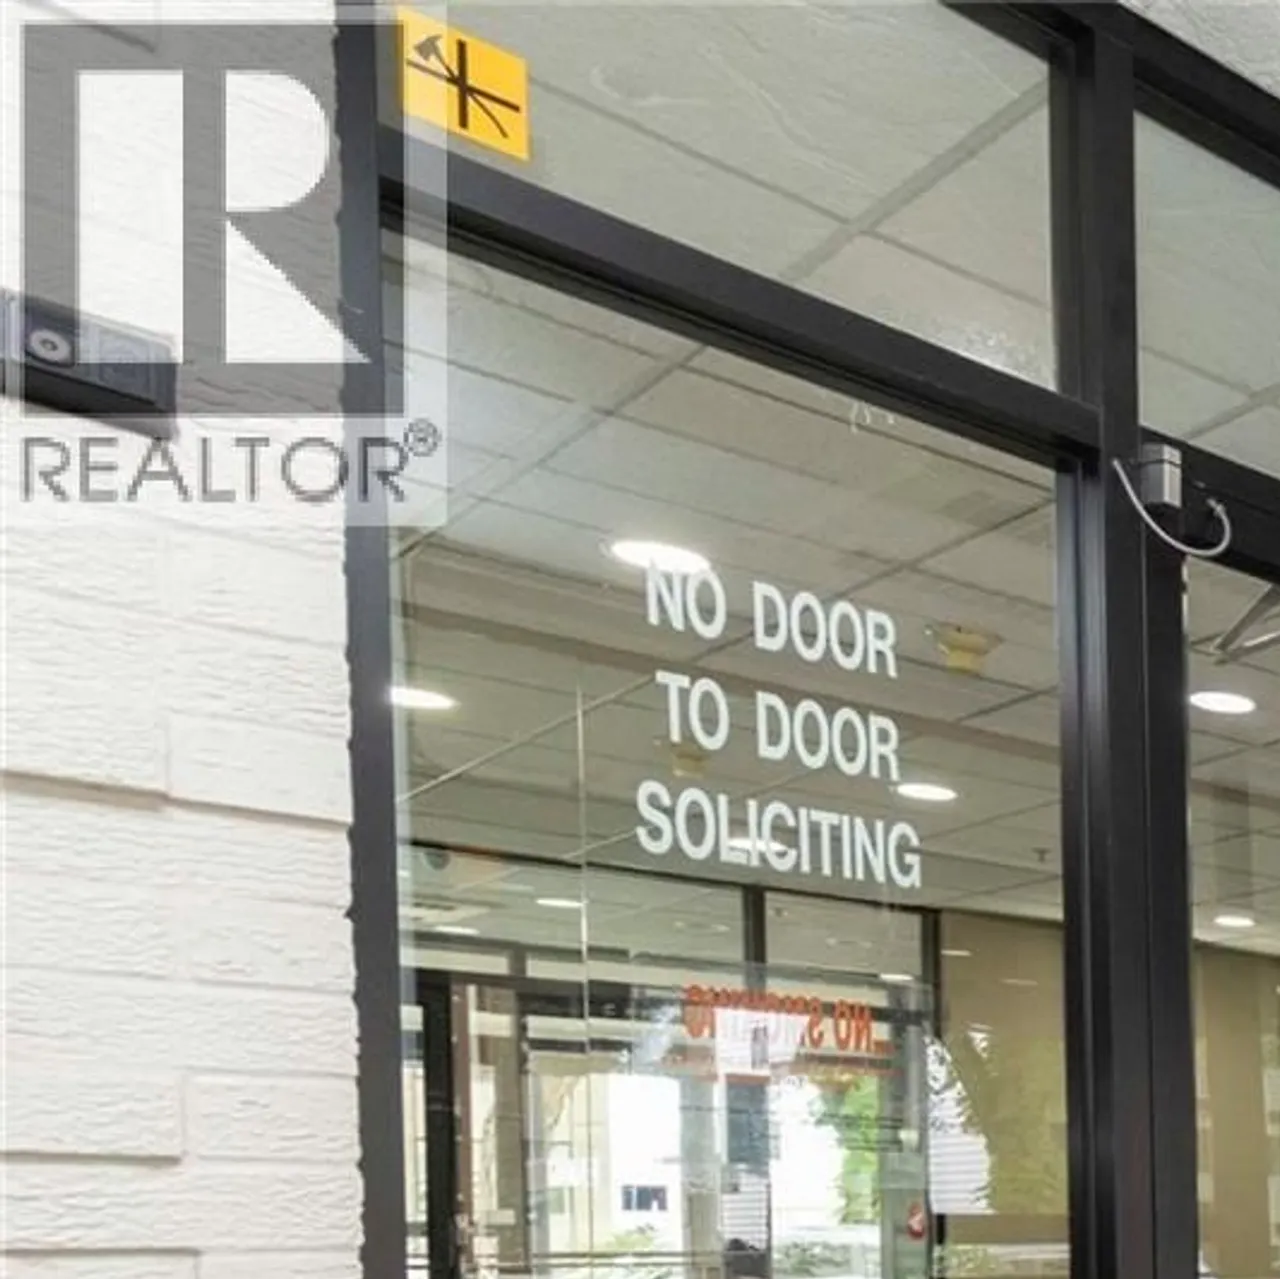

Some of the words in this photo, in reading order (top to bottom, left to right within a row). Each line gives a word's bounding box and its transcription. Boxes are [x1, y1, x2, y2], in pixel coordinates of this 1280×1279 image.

[645, 564, 727, 639] NO
[753, 580, 898, 679] DOOR
[655, 669, 730, 750] TO
[756, 690, 899, 781] DOOR
[636, 779, 922, 889] SOLICITING
